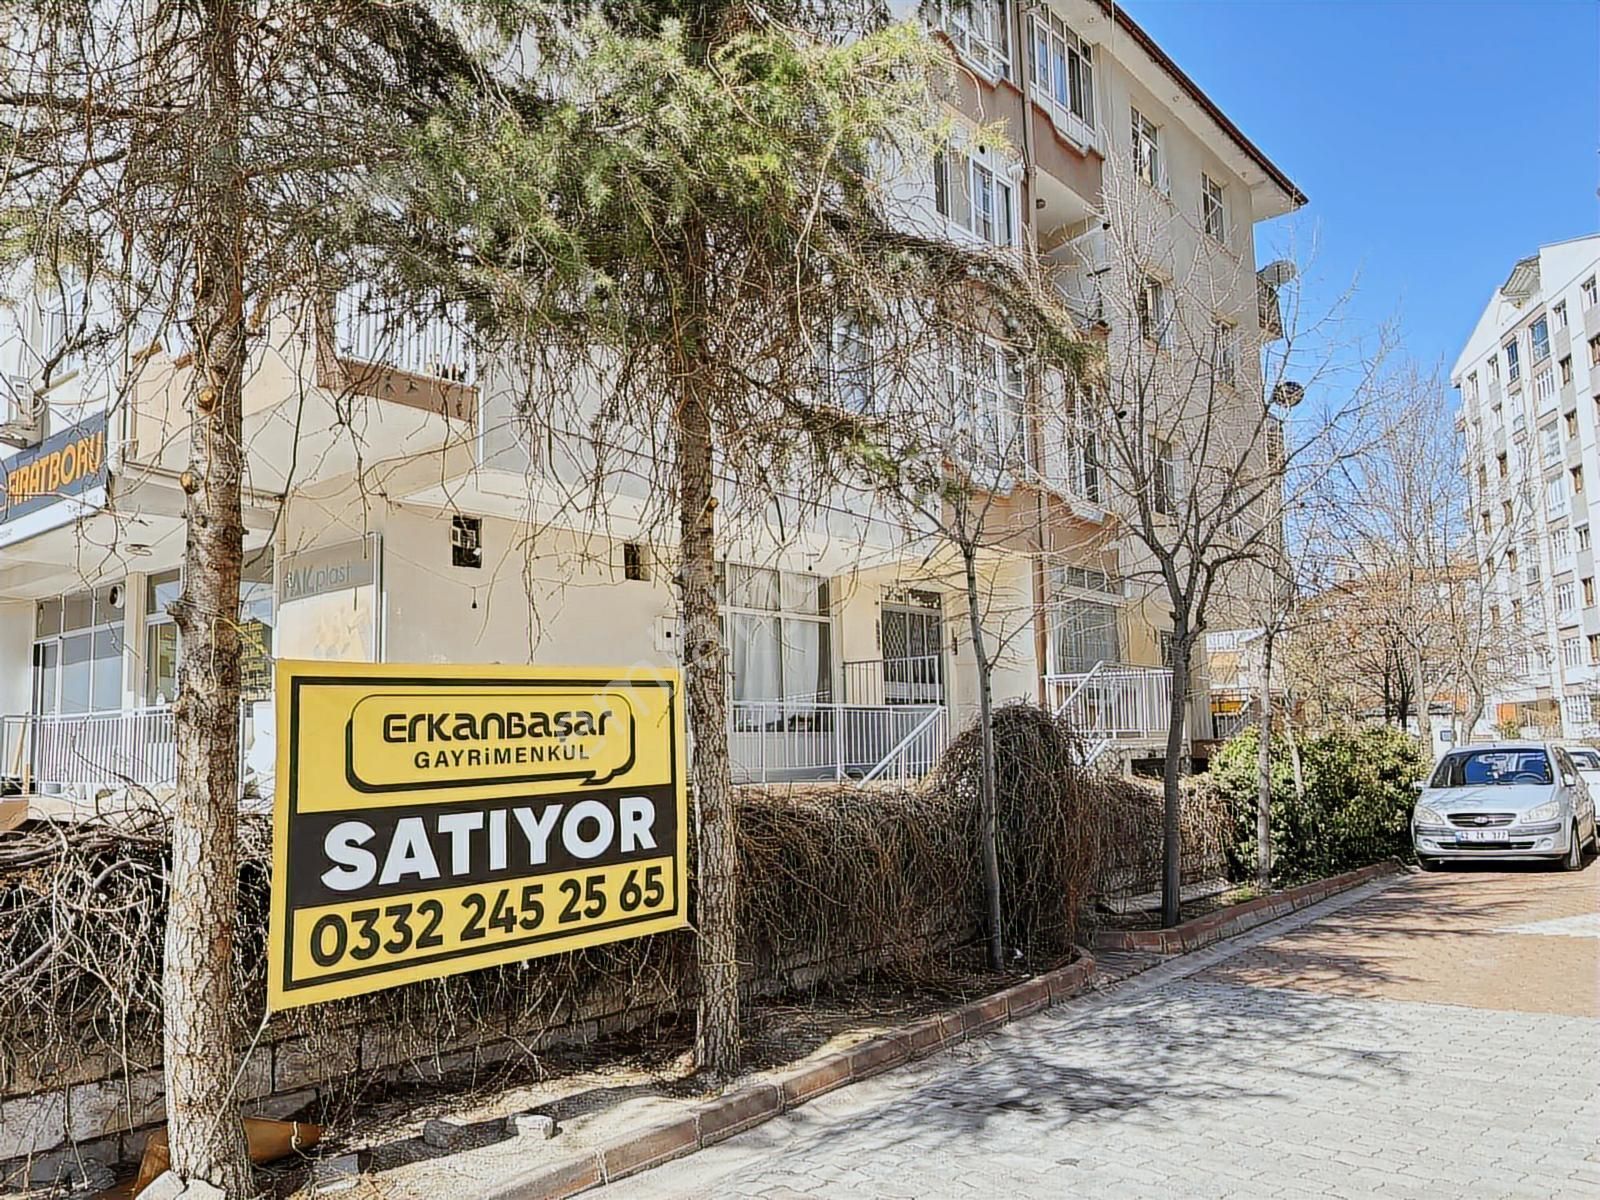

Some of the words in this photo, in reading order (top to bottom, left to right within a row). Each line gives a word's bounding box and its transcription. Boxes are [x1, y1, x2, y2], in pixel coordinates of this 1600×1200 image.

[320, 796, 658, 892] SATIYOR
[310, 899, 444, 967] 0332
[460, 883, 545, 941] 245
[558, 874, 607, 924] 25
[619, 865, 665, 912] 65
